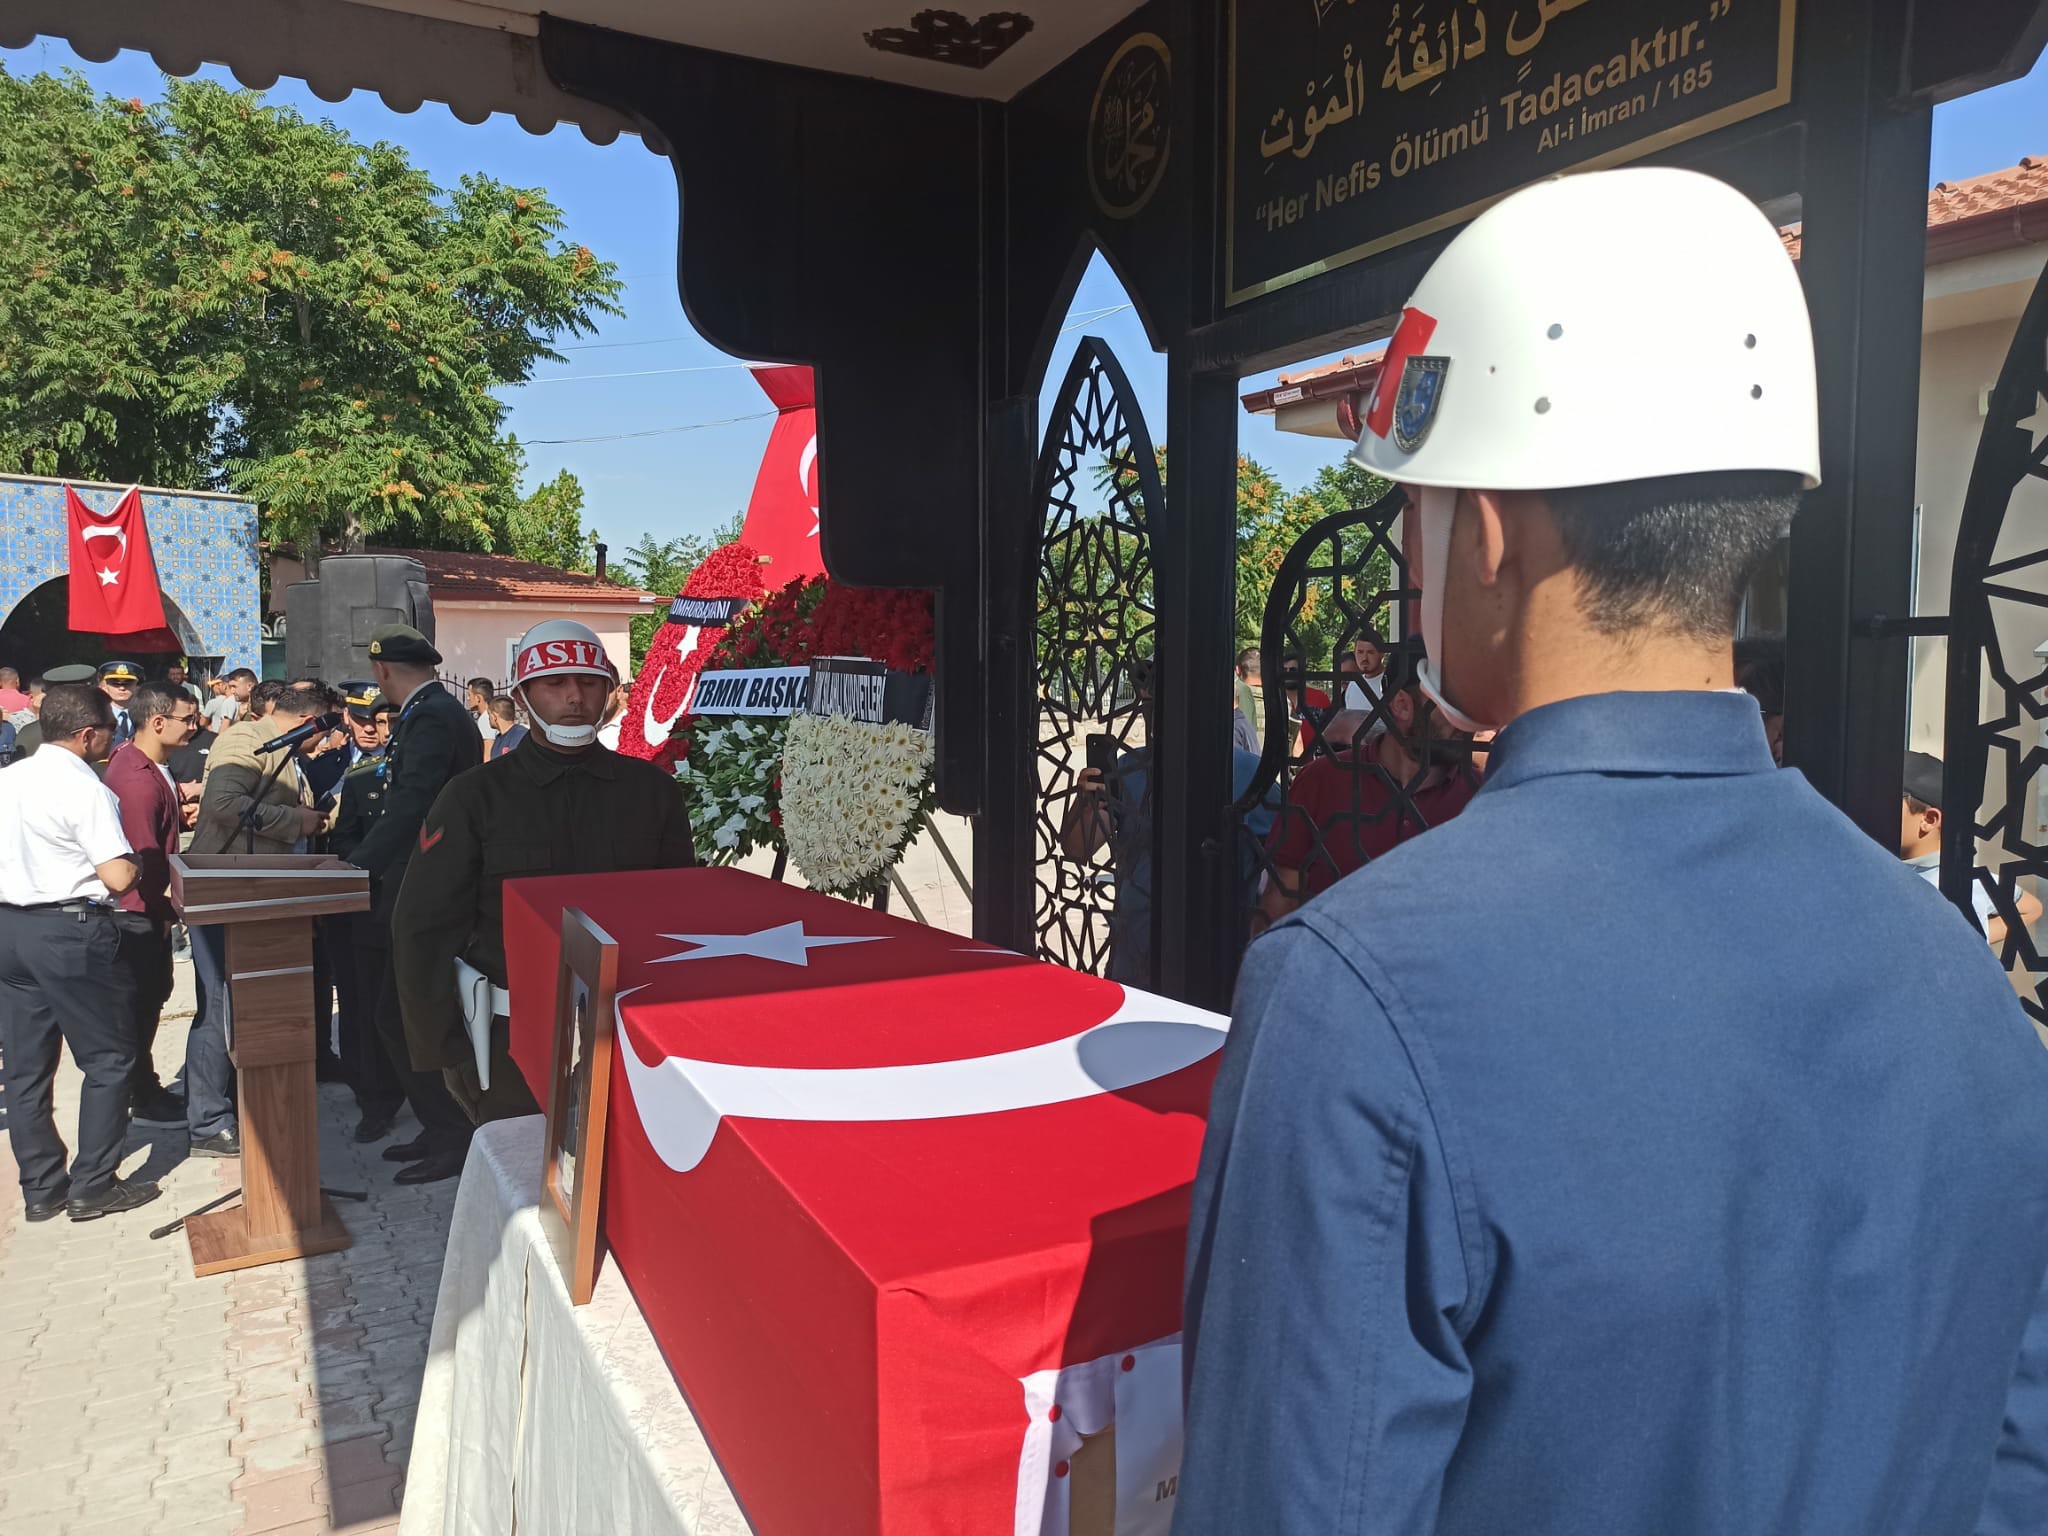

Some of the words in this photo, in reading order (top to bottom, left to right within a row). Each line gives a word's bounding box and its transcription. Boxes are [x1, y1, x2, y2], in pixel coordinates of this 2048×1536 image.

[1581, 94, 1645, 137] İmran
[1652, 81, 1662, 109] /
[1669, 60, 1713, 100] 185
[1315, 159, 1381, 212] Nefis
[1390, 106, 1489, 178] Ölümü
[693, 677, 749, 708] TBMM
[745, 676, 810, 714] BAŞKA
[1155, 1475, 1177, 1502] M
